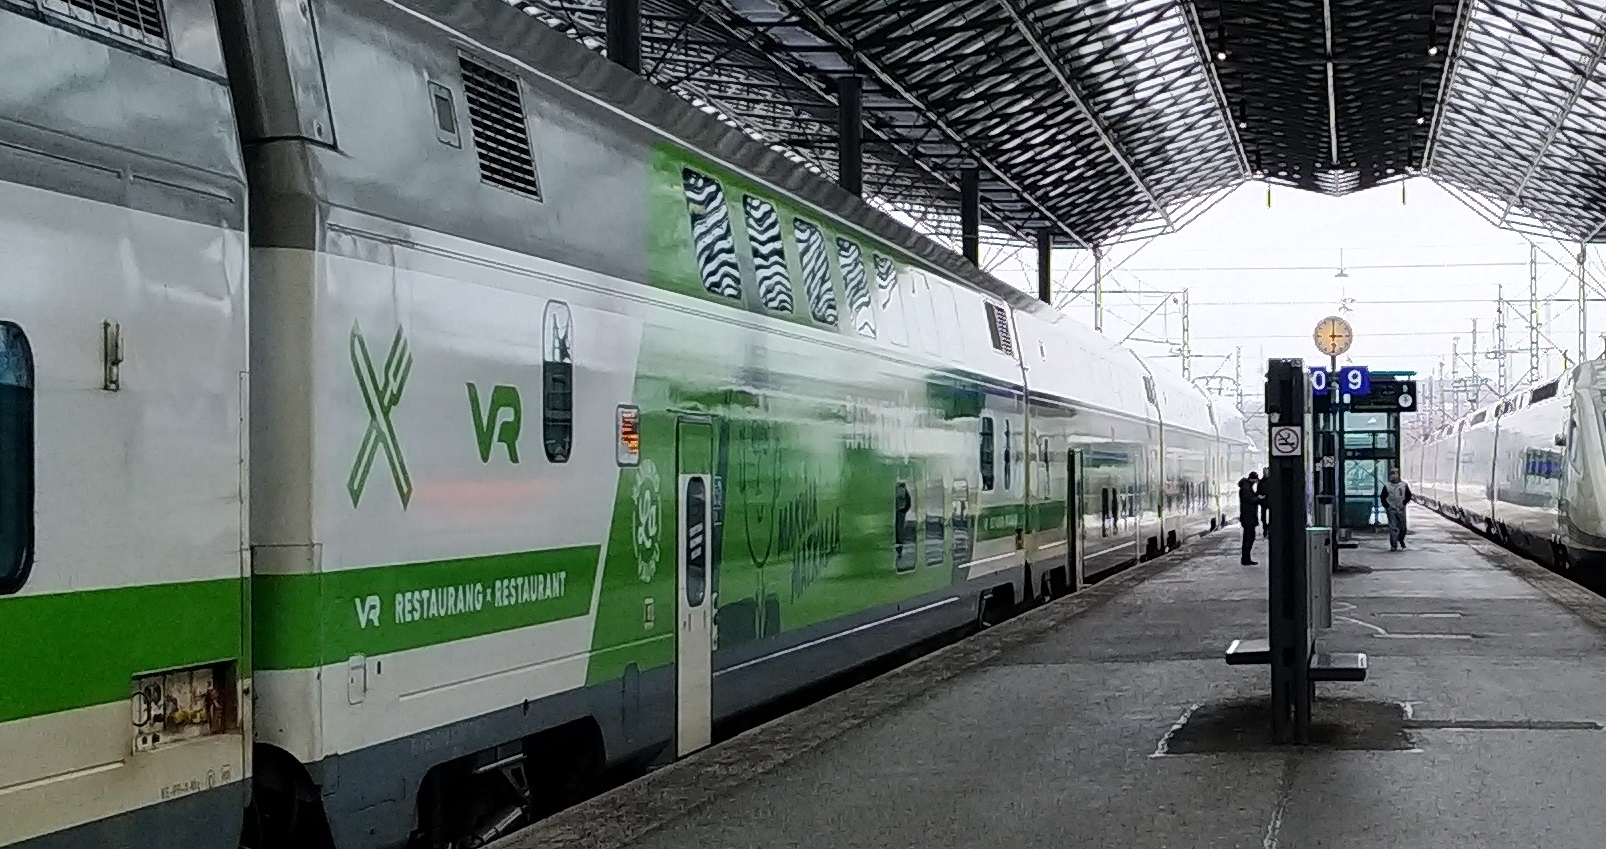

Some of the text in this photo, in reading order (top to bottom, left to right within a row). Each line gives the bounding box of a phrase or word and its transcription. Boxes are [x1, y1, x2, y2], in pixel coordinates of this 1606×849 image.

[1347, 369, 1362, 390] 9
[466, 381, 521, 464] VR
[354, 570, 567, 629] VR RESTAURANG RESTAURANT
